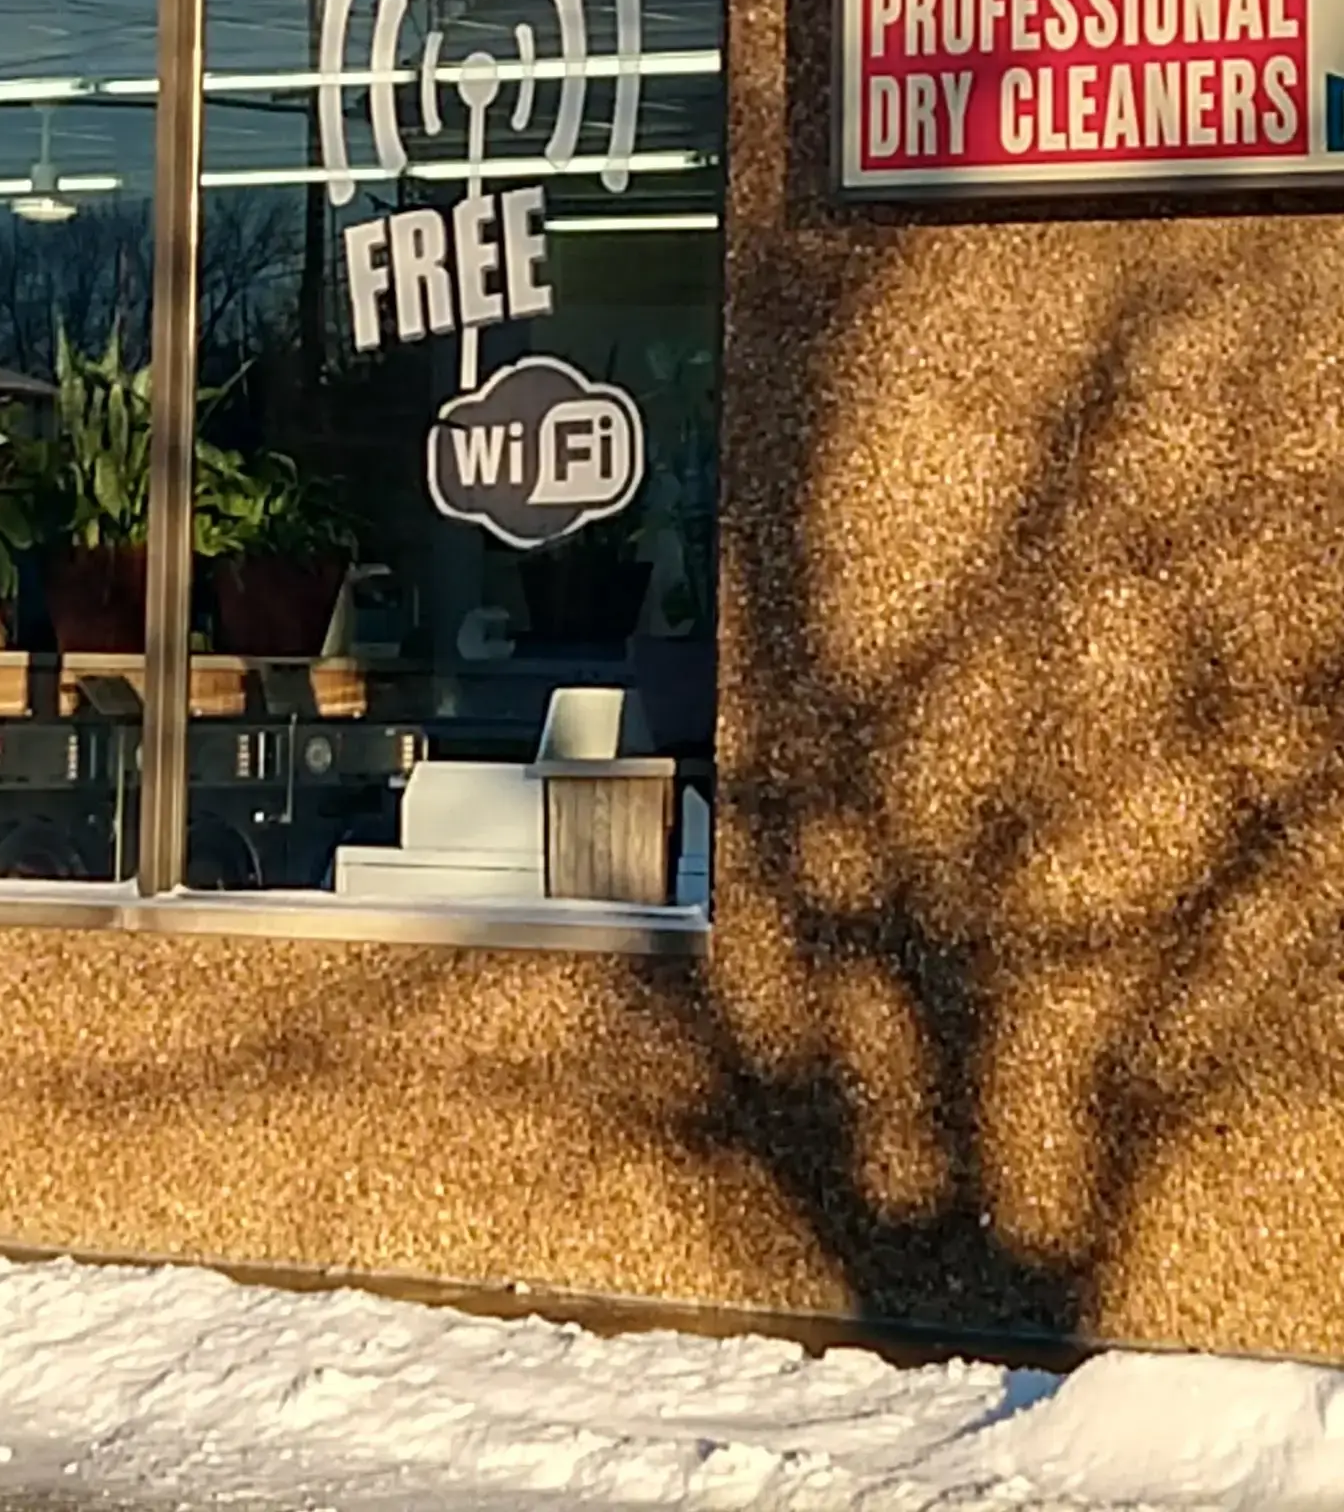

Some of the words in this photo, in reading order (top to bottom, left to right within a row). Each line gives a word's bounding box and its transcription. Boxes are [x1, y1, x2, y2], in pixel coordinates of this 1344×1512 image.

[868, 71, 974, 158] DRY
[999, 55, 1298, 155] CLEANERS
[344, 185, 553, 352] FREE
